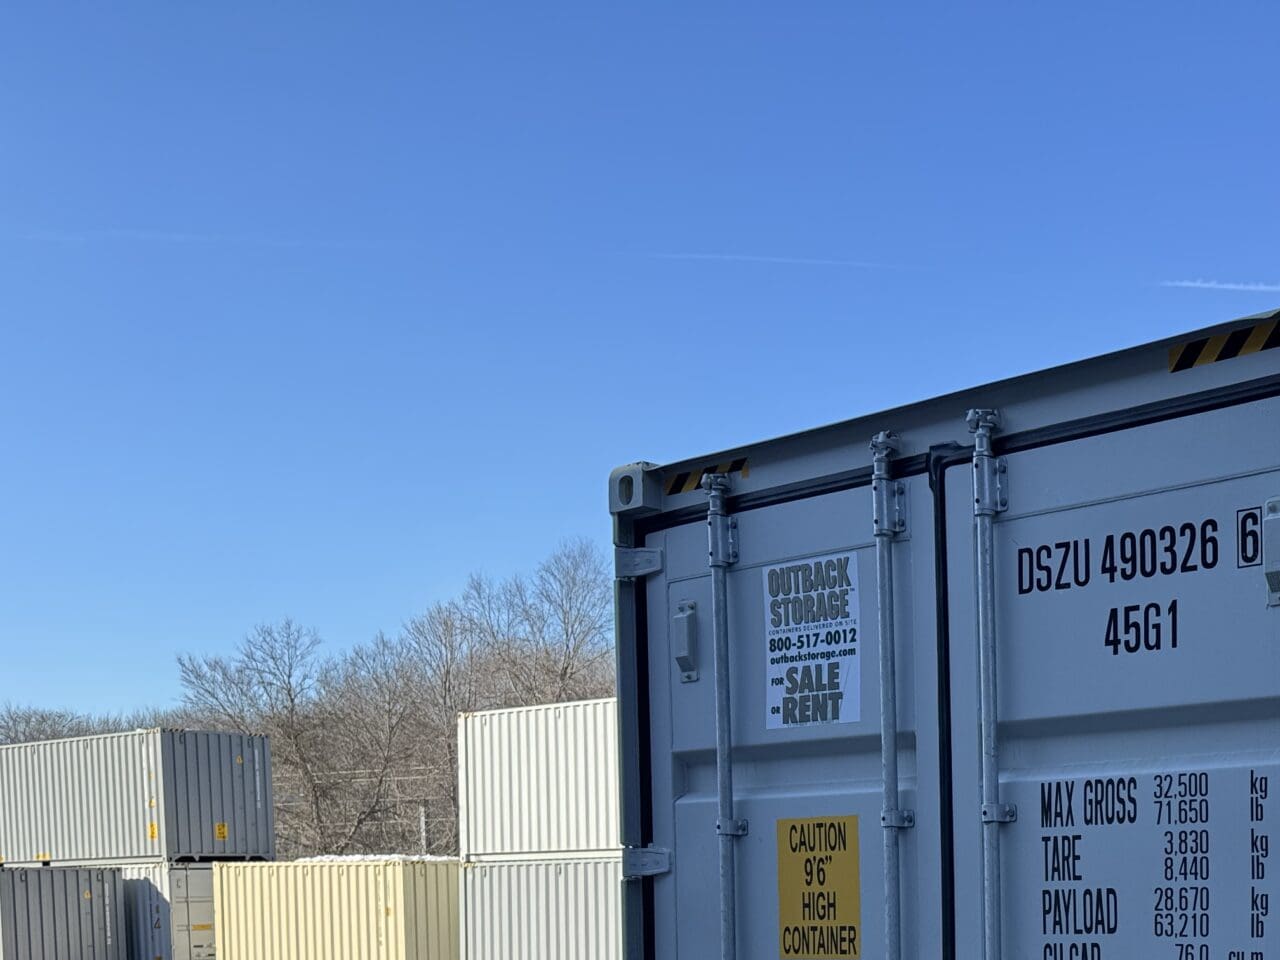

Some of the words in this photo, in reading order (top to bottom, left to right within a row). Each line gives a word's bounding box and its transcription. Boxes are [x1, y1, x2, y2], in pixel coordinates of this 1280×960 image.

[1017, 538, 1090, 595] DSZU
[1100, 518, 1219, 583] 490326
[1240, 511, 1259, 564] 6
[768, 556, 851, 598] OUTBACK
[770, 588, 850, 628] STORAGE
[769, 627, 857, 653] 800-517-0012
[1104, 599, 1178, 655] 45G1
[770, 647, 856, 665] outbackstorage.com
[771, 677, 784, 687] FOR
[785, 662, 840, 695] SALE
[771, 706, 781, 714] OR
[782, 692, 843, 724] RENT
[1040, 780, 1075, 828] MAX
[1083, 776, 1137, 826] GROSS
[1153, 772, 1209, 799] 32,500
[1249, 769, 1268, 799] kg
[1153, 798, 1209, 825] 71,650
[1250, 797, 1264, 822] lb
[789, 821, 847, 853] CAUTION
[1041, 834, 1082, 882] TARE
[1164, 829, 1209, 856] 3,830
[1250, 828, 1269, 858] kg
[1164, 856, 1209, 882] 8,440
[1250, 854, 1265, 880] lb
[802, 891, 837, 921] HIGH
[1042, 888, 1118, 935] PAYLOAD
[1153, 886, 1209, 913] 28,670
[1250, 886, 1269, 917] kg
[783, 925, 857, 955] CONTAINER
[1153, 913, 1209, 939] 63,210
[1250, 913, 1264, 938] lb
